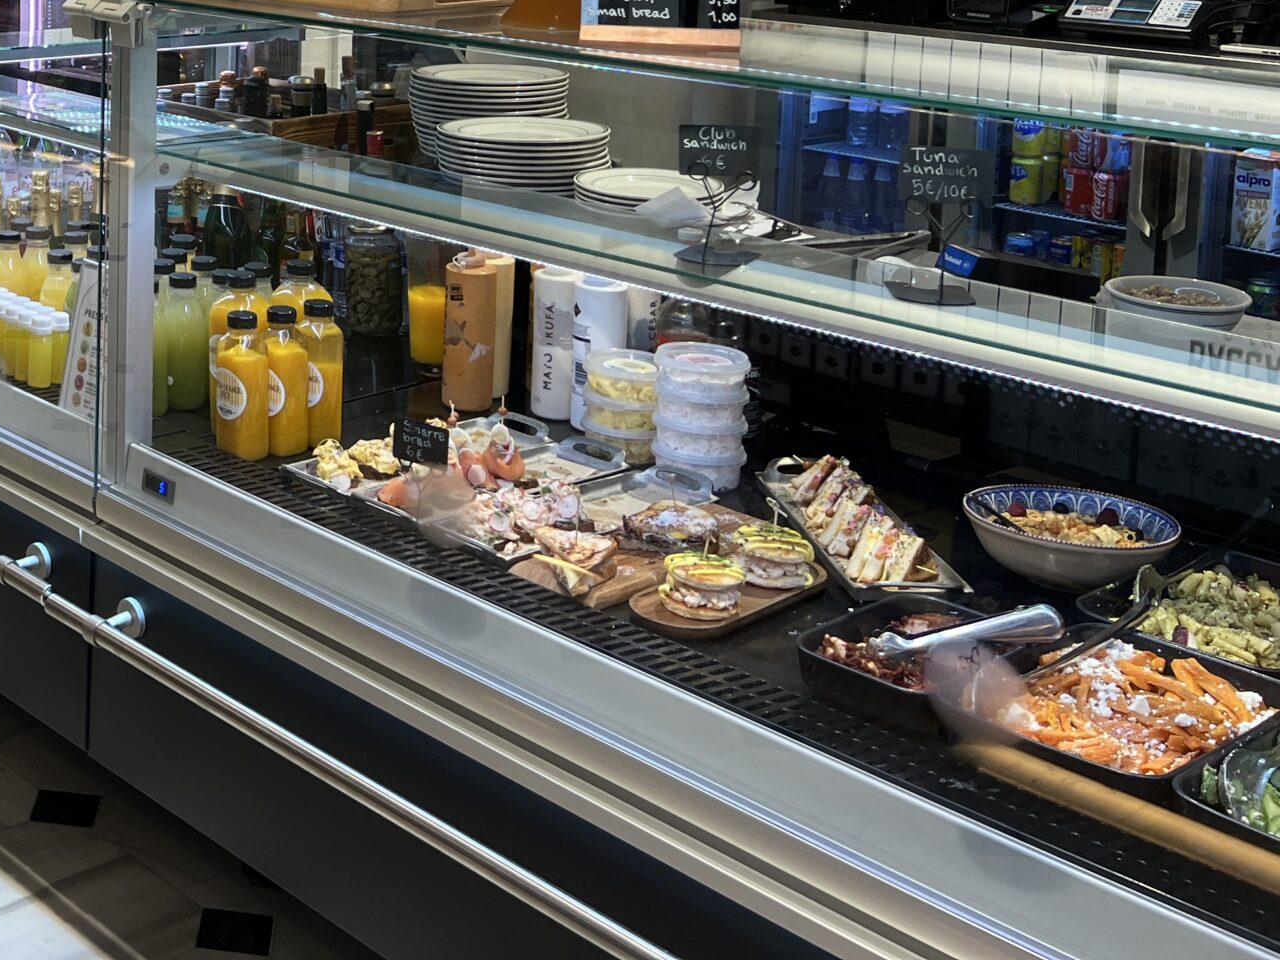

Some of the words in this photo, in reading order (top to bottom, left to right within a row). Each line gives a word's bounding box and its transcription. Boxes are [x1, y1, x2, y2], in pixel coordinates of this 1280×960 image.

[632, 7, 670, 20] bread
[699, 126, 736, 140] Club
[910, 146, 959, 164] Tuna
[67, 178, 94, 192] evia
[1236, 172, 1271, 188] alpro
